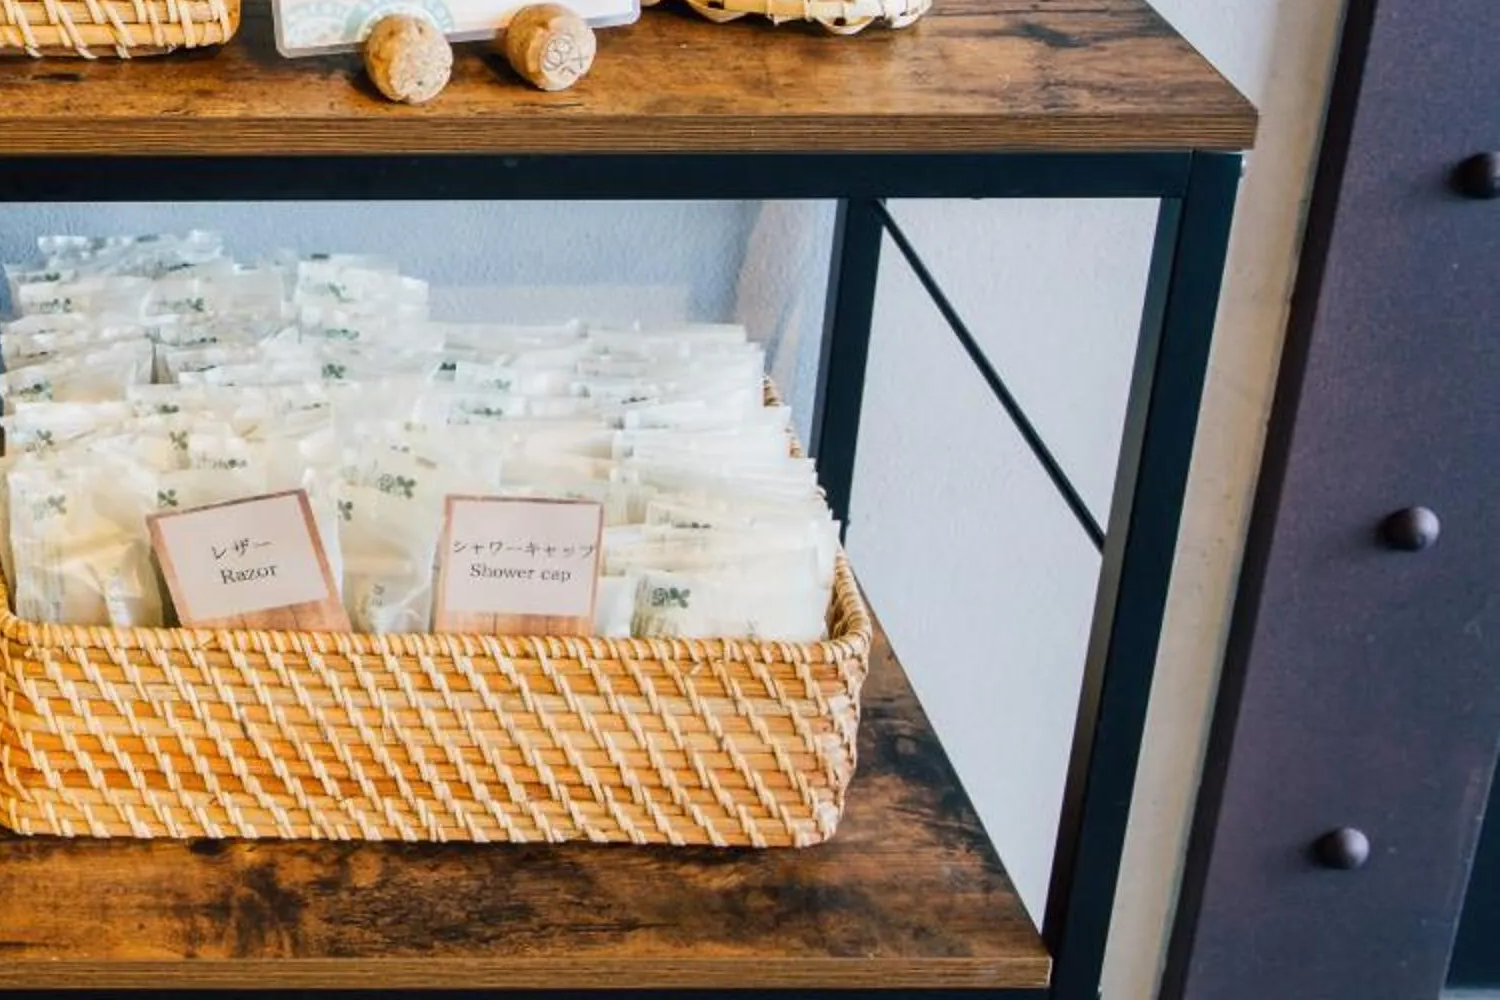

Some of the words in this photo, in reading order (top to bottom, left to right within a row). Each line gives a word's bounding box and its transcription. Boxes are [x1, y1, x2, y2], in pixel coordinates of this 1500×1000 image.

[211, 538, 276, 560] レザー
[220, 565, 277, 584] Razor
[469, 562, 535, 580] Shower
[541, 569, 572, 583] cap
